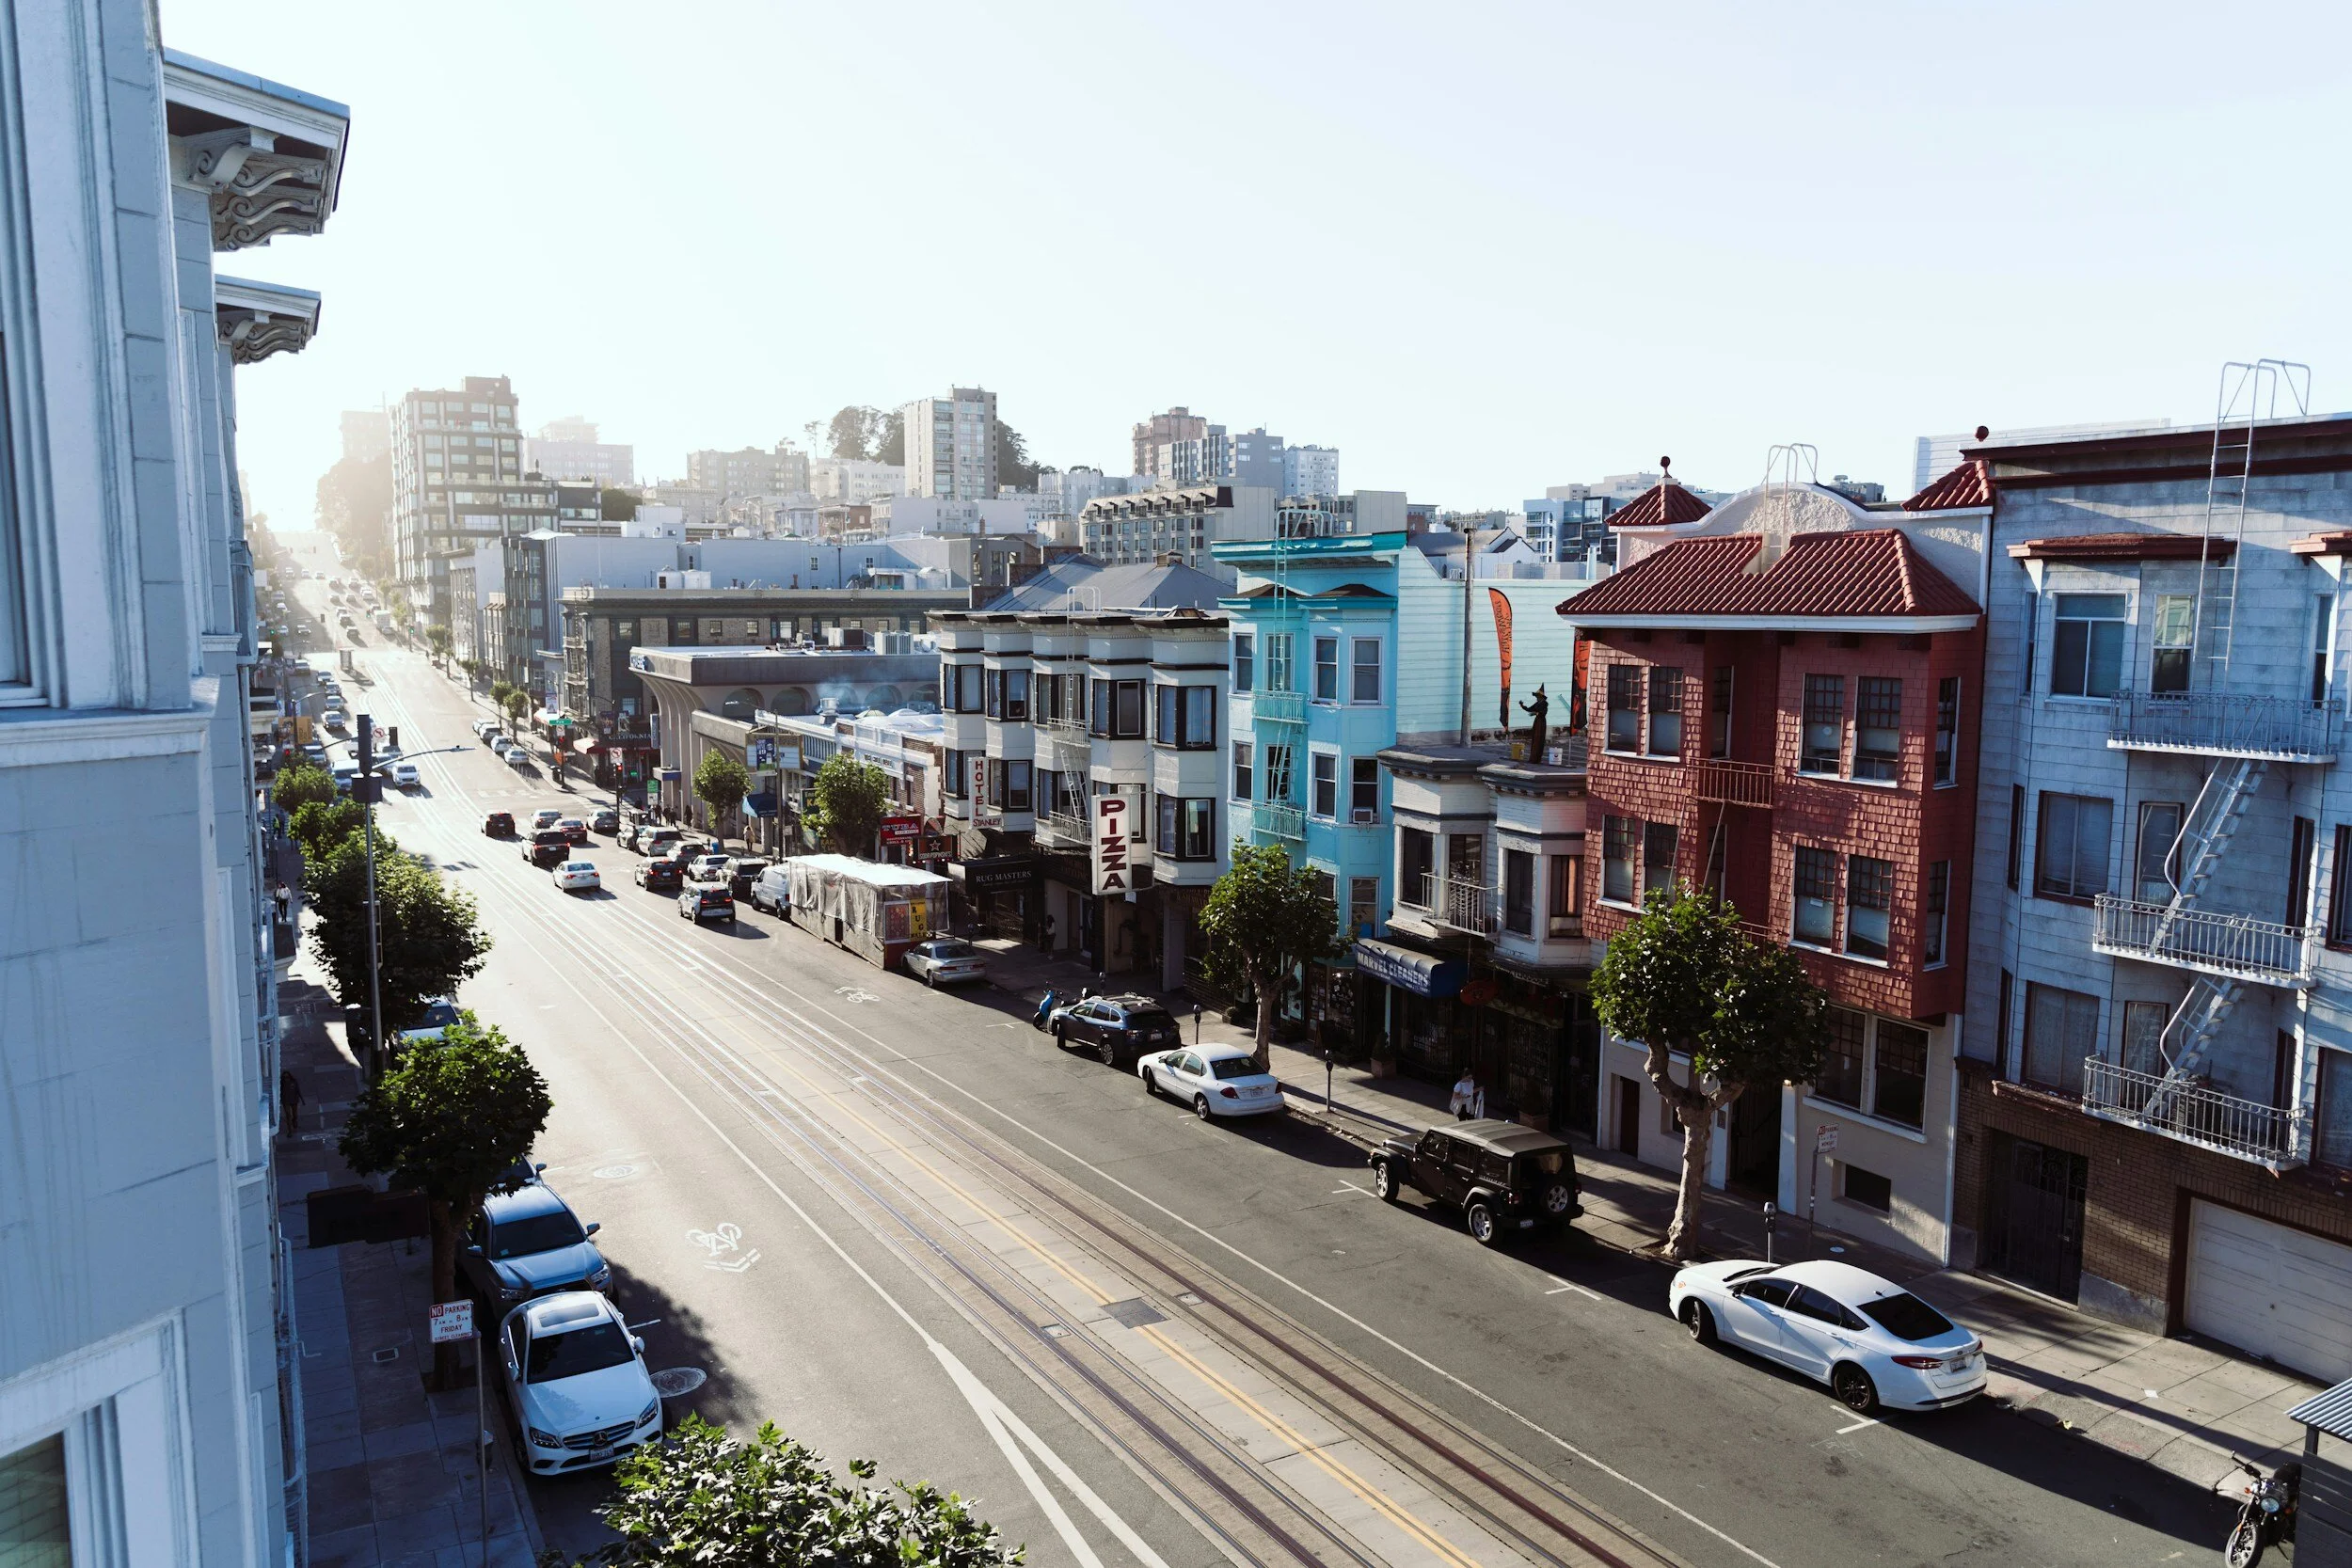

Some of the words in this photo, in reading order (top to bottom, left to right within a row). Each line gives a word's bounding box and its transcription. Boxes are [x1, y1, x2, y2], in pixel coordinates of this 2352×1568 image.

[975, 760, 984, 816] HOTEL
[882, 822, 919, 832] TUBA
[973, 817, 1001, 827] STANLEY
[1100, 800, 1127, 890] PIZZA
[976, 874, 993, 883] RUG
[994, 870, 1032, 881] MASTERS
[1357, 951, 1388, 974] MARVEL
[1389, 962, 1429, 989] CLEANERS
[431, 1307, 442, 1317] NO
[444, 1304, 470, 1314] PARKING
[440, 1324, 463, 1334] FRIDAY
